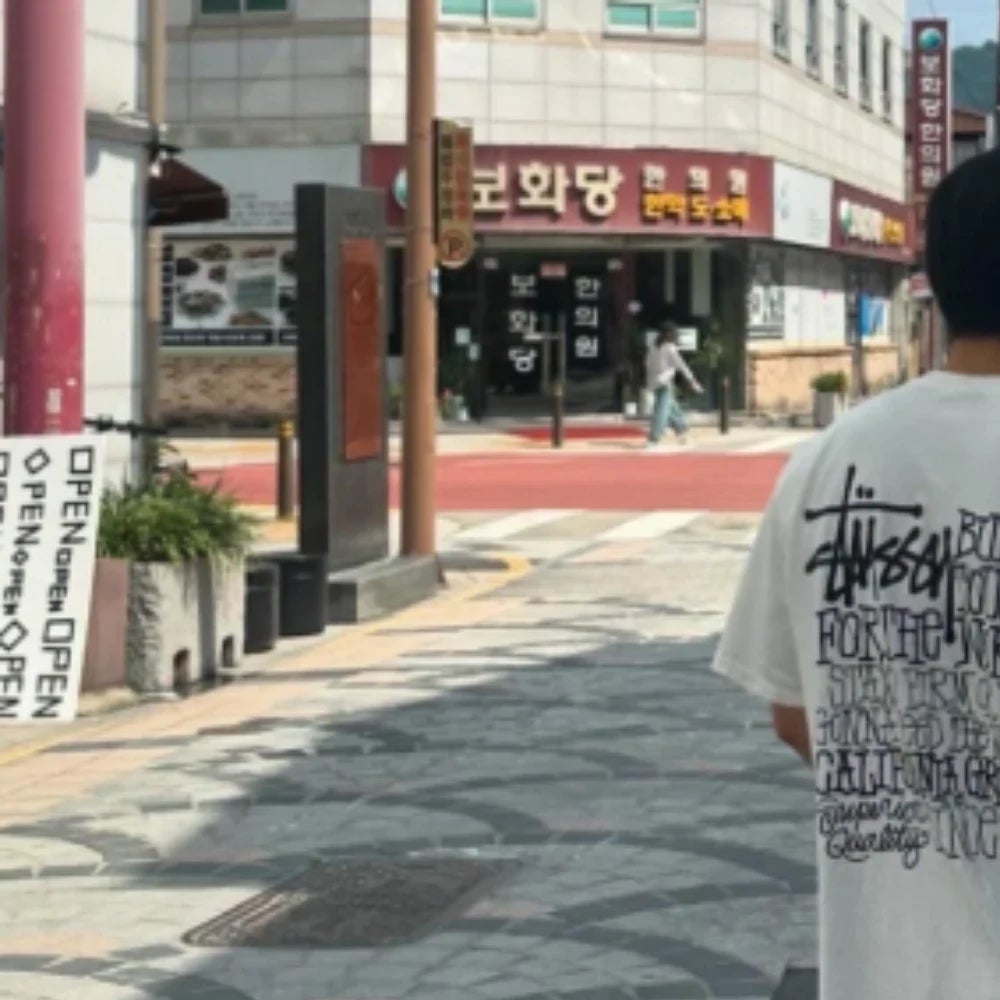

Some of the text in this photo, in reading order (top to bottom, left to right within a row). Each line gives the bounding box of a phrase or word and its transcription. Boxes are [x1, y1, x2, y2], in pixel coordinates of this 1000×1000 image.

[473, 162, 623, 216] 보화당
[14, 448, 51, 545] OPEN
[60, 446, 95, 545] OPEN
[32, 617, 76, 718] OPEN
